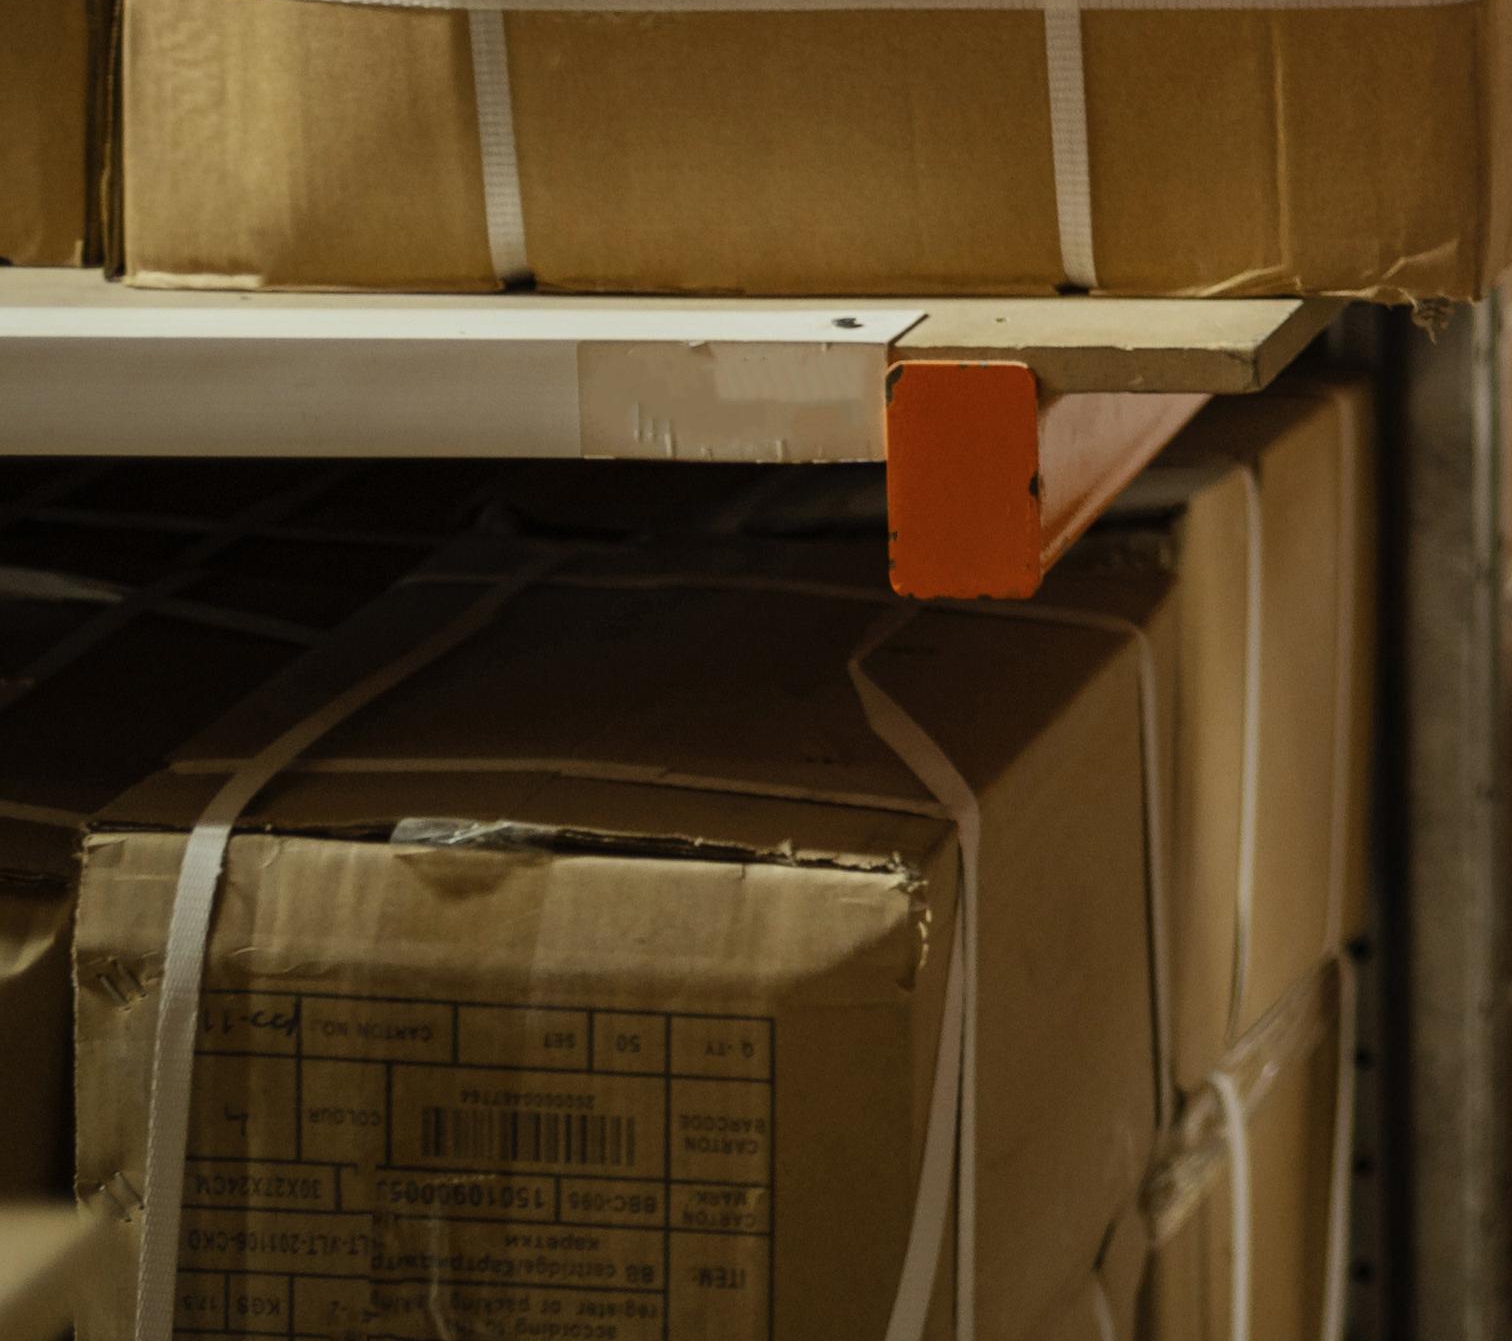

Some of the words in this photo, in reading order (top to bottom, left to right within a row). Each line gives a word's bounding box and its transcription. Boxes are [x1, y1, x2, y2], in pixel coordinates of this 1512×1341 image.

[308, 1107, 382, 1129] COLOUR
[683, 1137, 760, 1156] CARTON
[236, 1295, 281, 1316] KGS
